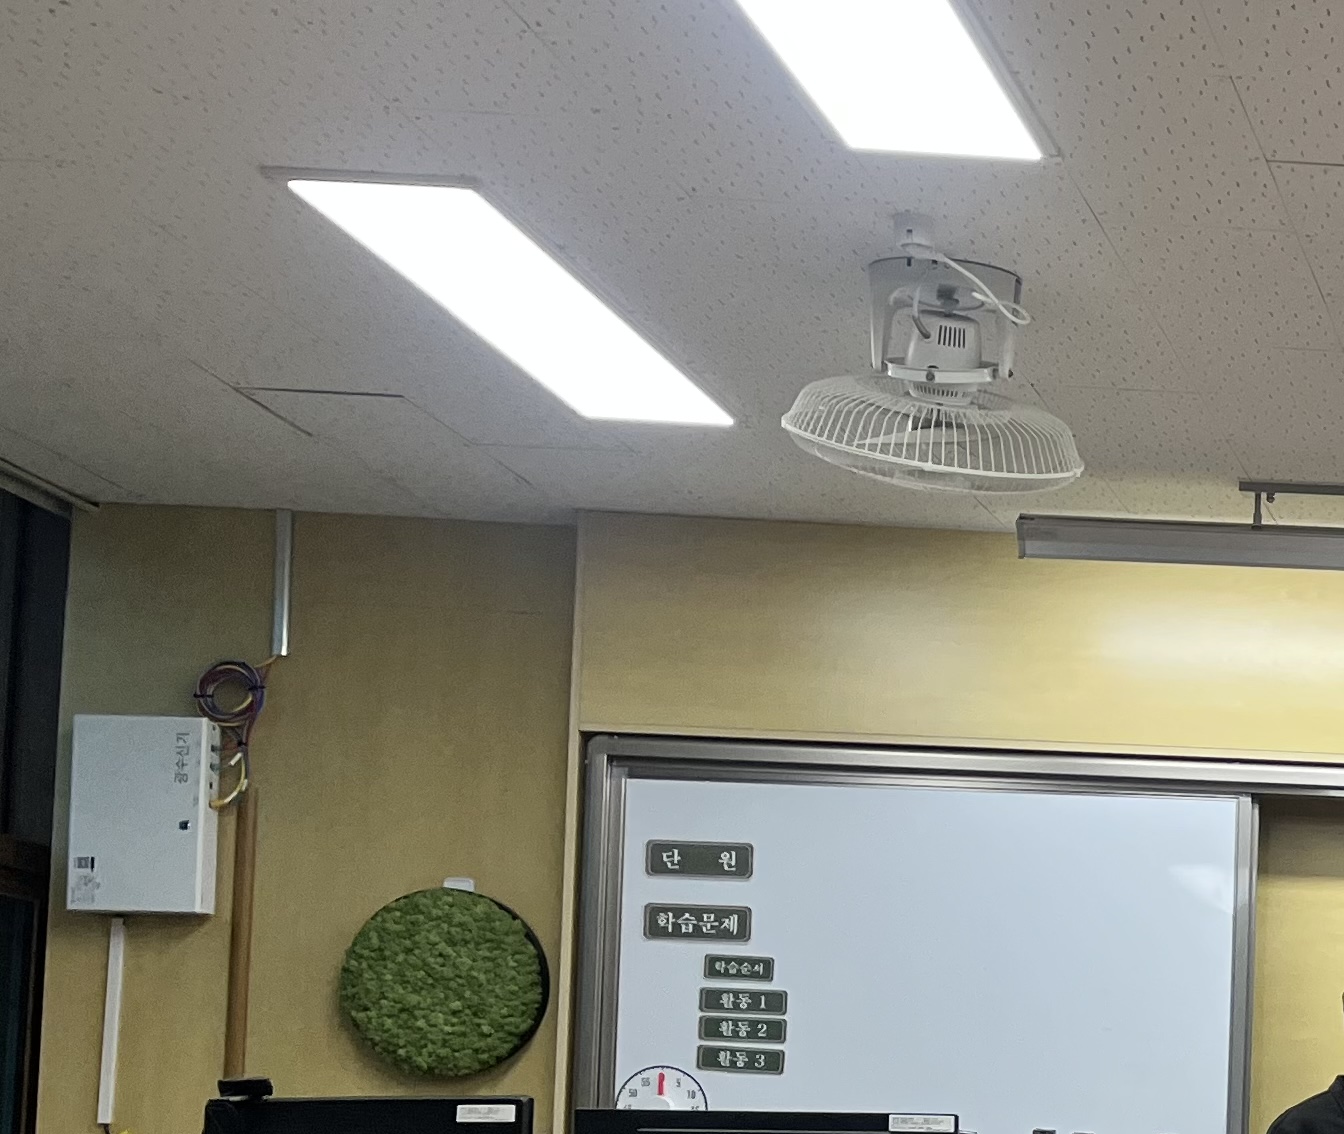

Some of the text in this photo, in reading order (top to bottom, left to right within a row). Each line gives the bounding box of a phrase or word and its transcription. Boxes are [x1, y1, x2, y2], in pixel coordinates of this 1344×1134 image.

[662, 849, 736, 871] 단 원
[656, 912, 739, 936] 학습문제
[719, 992, 767, 1009] 활동 1
[718, 1020, 767, 1037] 활동 2
[716, 1050, 765, 1068] 활동 3
[686, 1089, 696, 1100] 10
